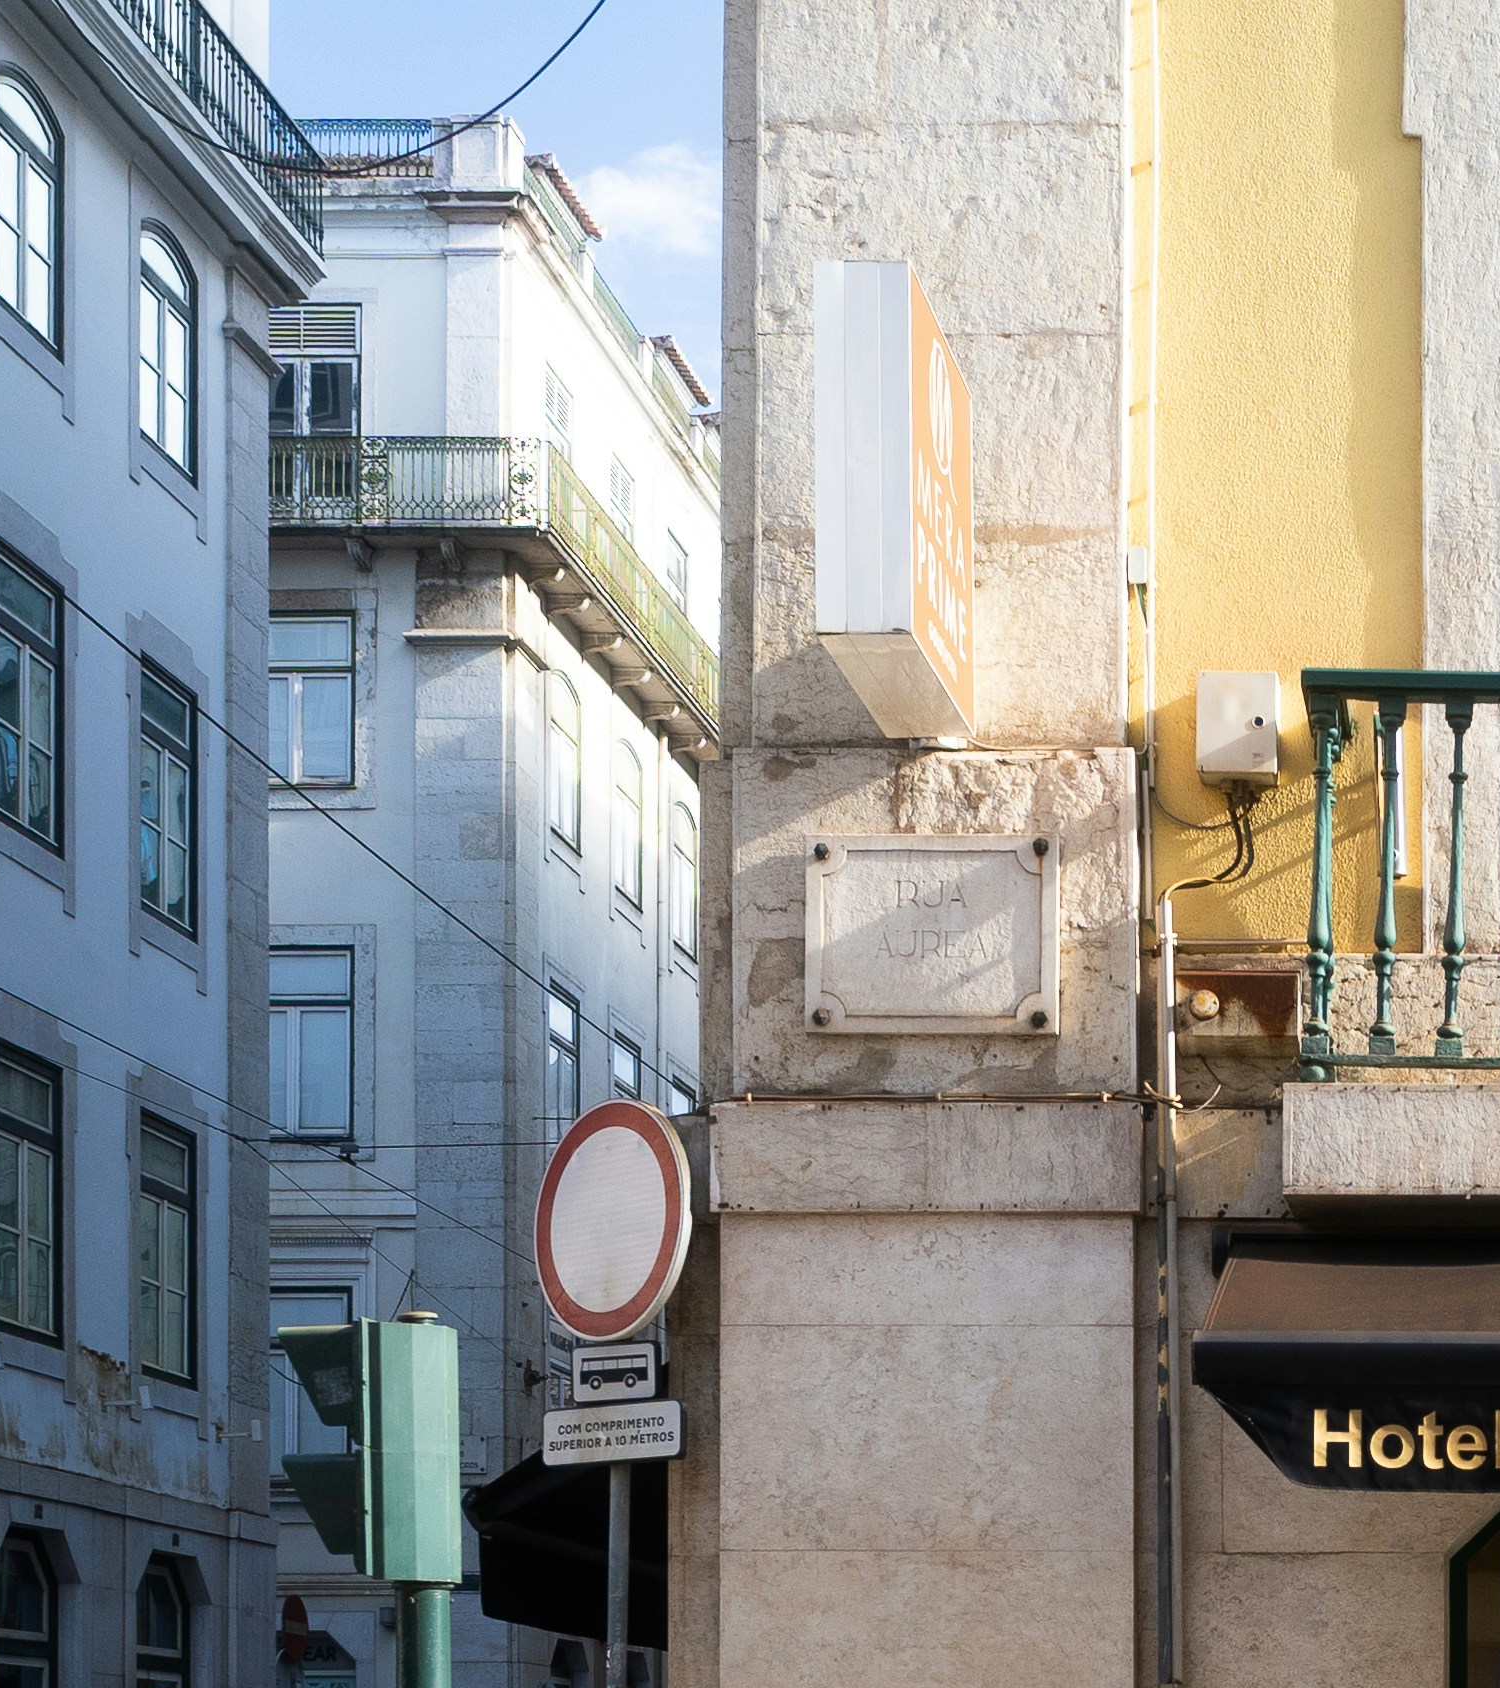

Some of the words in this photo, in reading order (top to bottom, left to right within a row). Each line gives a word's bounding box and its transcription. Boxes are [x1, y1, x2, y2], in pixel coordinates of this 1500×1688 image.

[917, 449, 966, 591] MERA
[917, 522, 967, 664] PRIME
[895, 879, 968, 909] RUA
[558, 1424, 581, 1436] COM
[585, 1416, 665, 1432] COMPRIMENTO
[549, 1438, 601, 1452] SUPERIOR
[605, 1436, 612, 1447] A
[615, 1435, 627, 1446] 10
